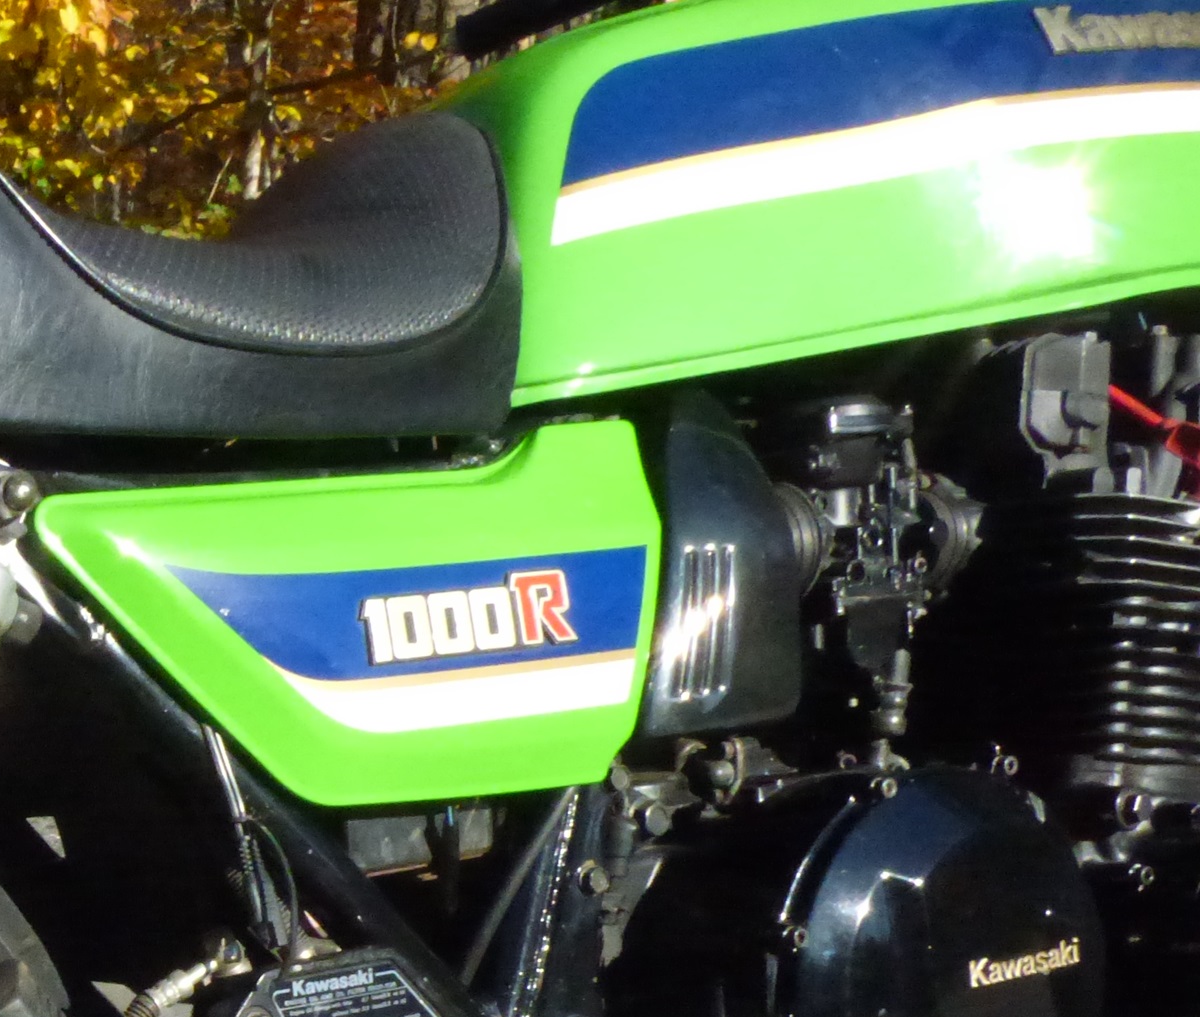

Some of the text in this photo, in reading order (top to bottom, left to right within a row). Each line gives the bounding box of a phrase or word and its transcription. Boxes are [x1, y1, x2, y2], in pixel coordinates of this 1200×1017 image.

[359, 568, 578, 666] 1000R
[292, 968, 375, 997] Kawasaki
[968, 937, 1081, 988] Kawasaki
